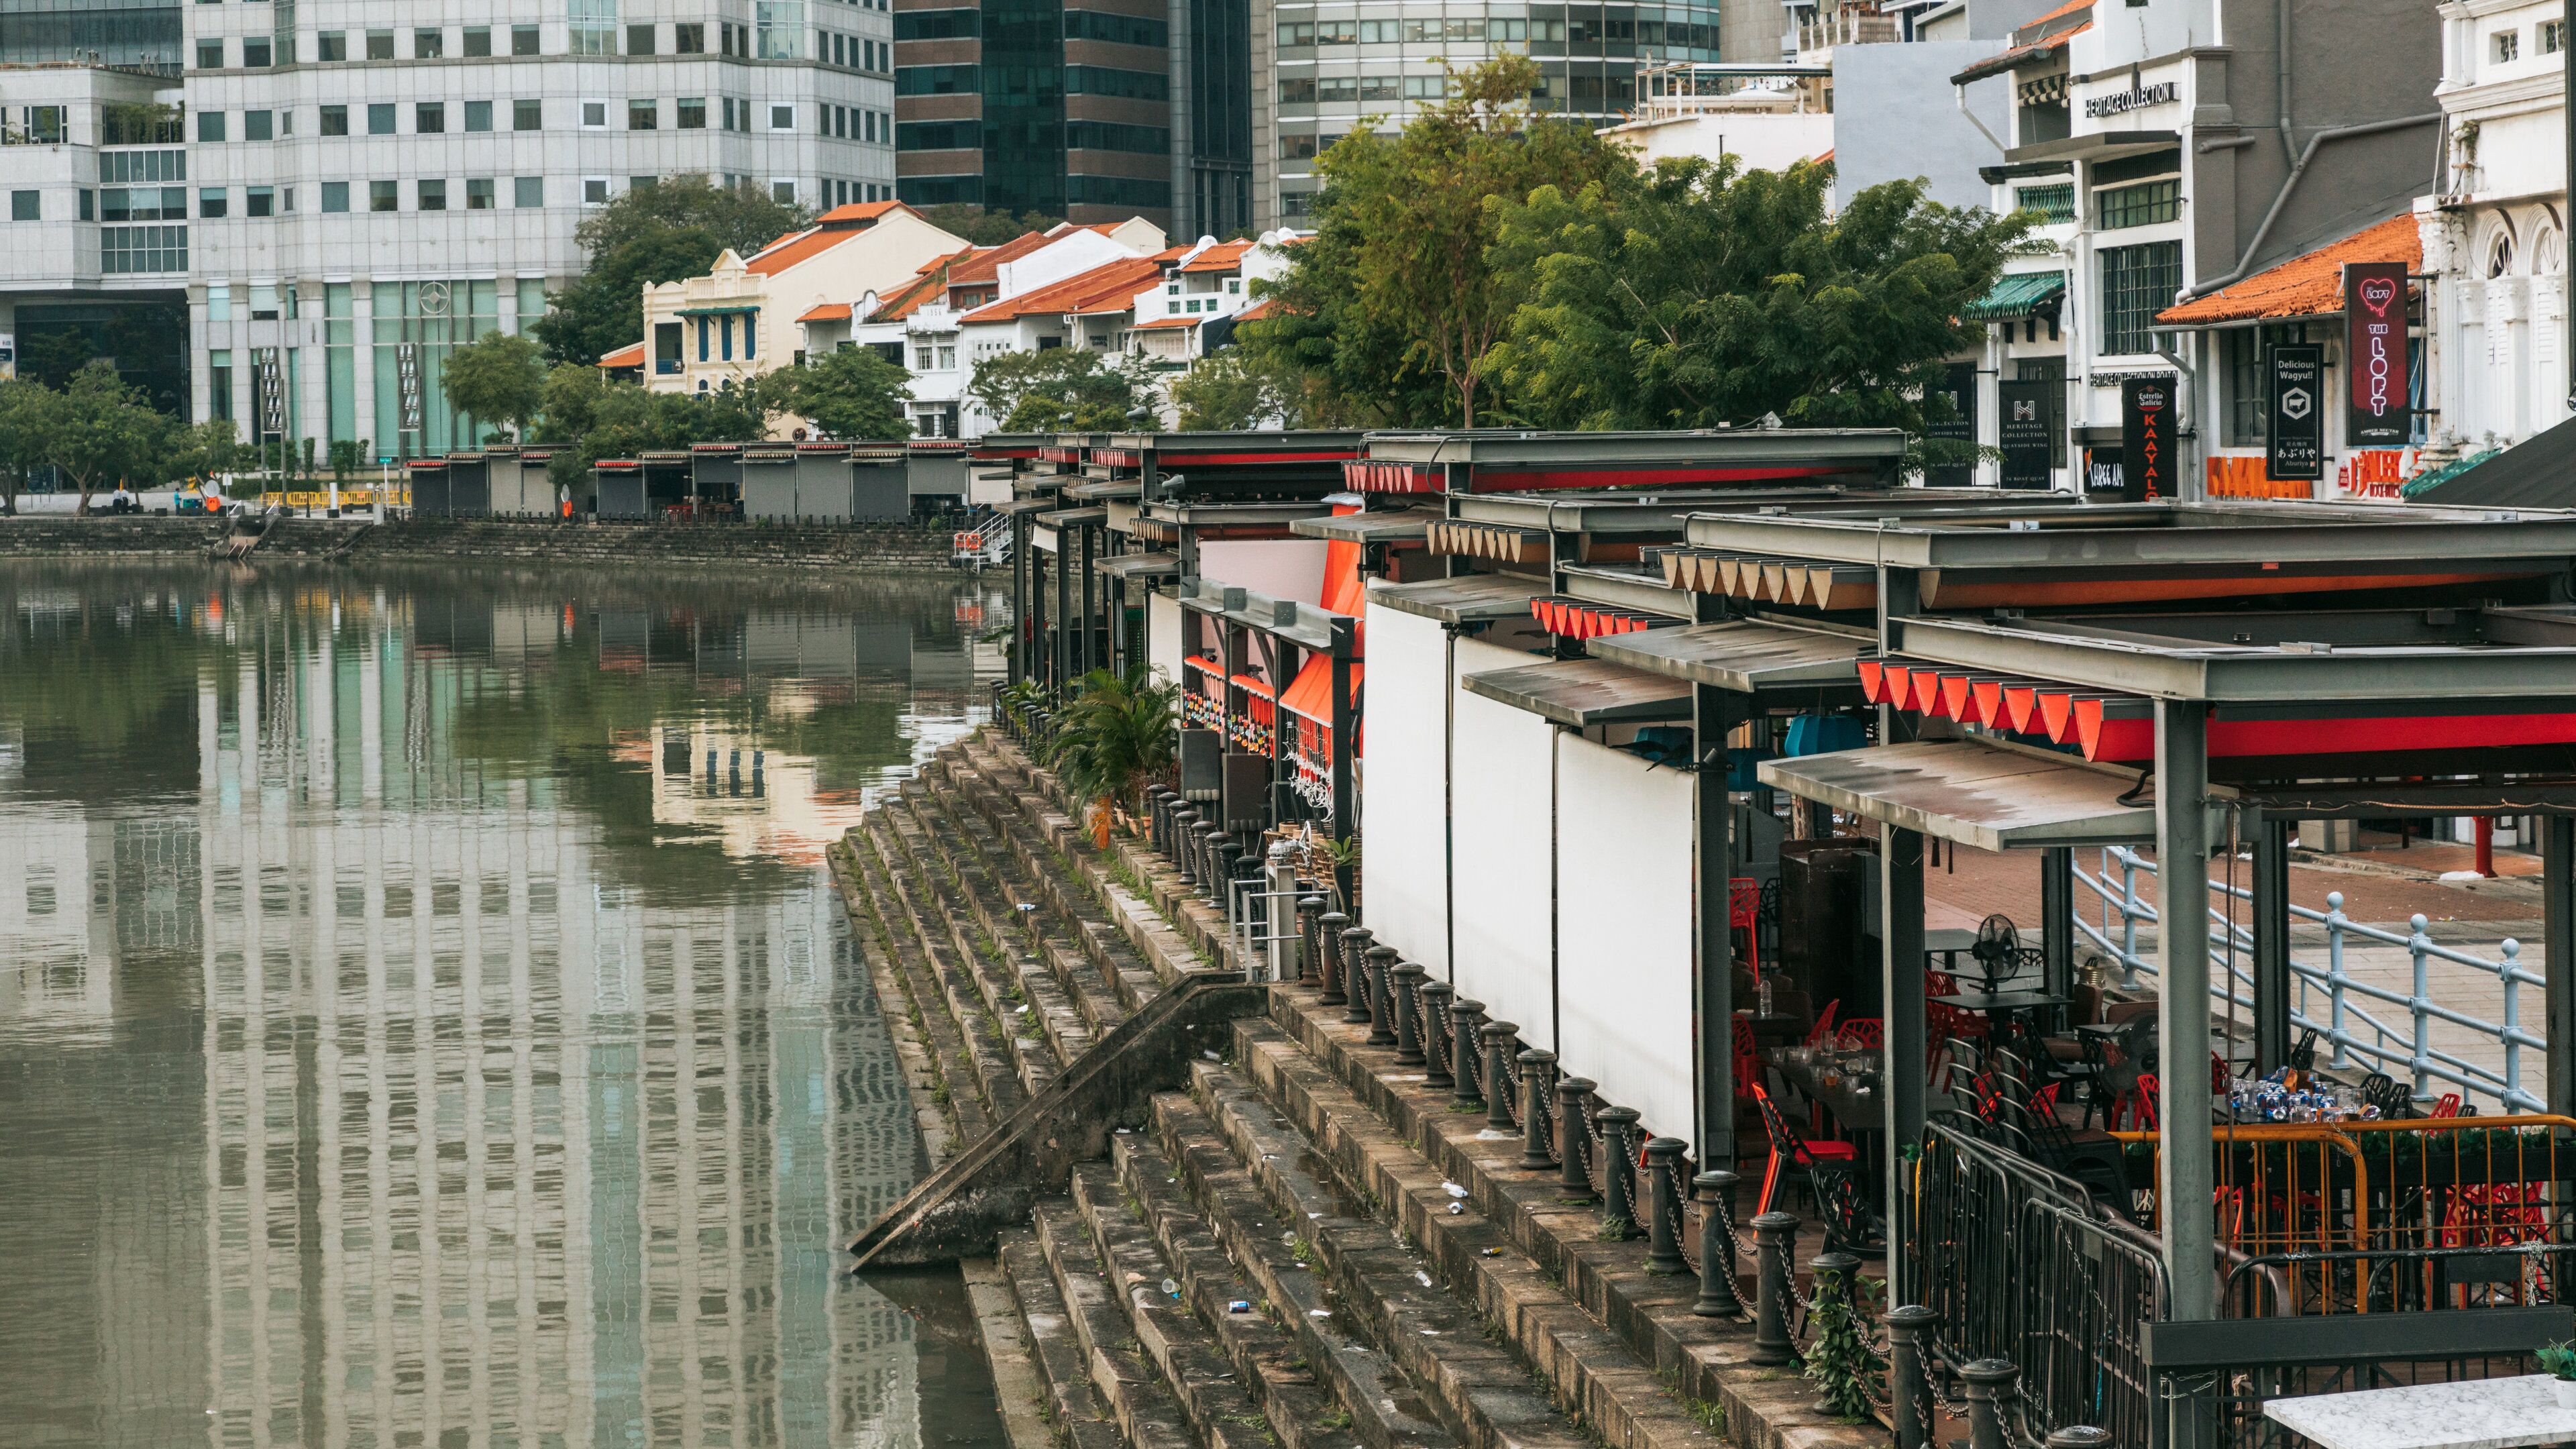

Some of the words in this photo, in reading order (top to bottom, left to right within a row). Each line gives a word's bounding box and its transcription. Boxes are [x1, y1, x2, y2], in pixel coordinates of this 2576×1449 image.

[2086, 94, 2121, 117] HERITAGE
[2121, 83, 2169, 110] COLLECTION
[2367, 289, 2390, 299] LOFT
[2369, 324, 2388, 333] THE
[2278, 360, 2315, 368] Delicious
[2090, 372, 2114, 386] HERITAGE
[2280, 371, 2313, 381] Wagyu!!
[2370, 337, 2388, 416] LOFT
[2278, 447, 2316, 459] あぶりや
[2285, 460, 2308, 468] Aburiya
